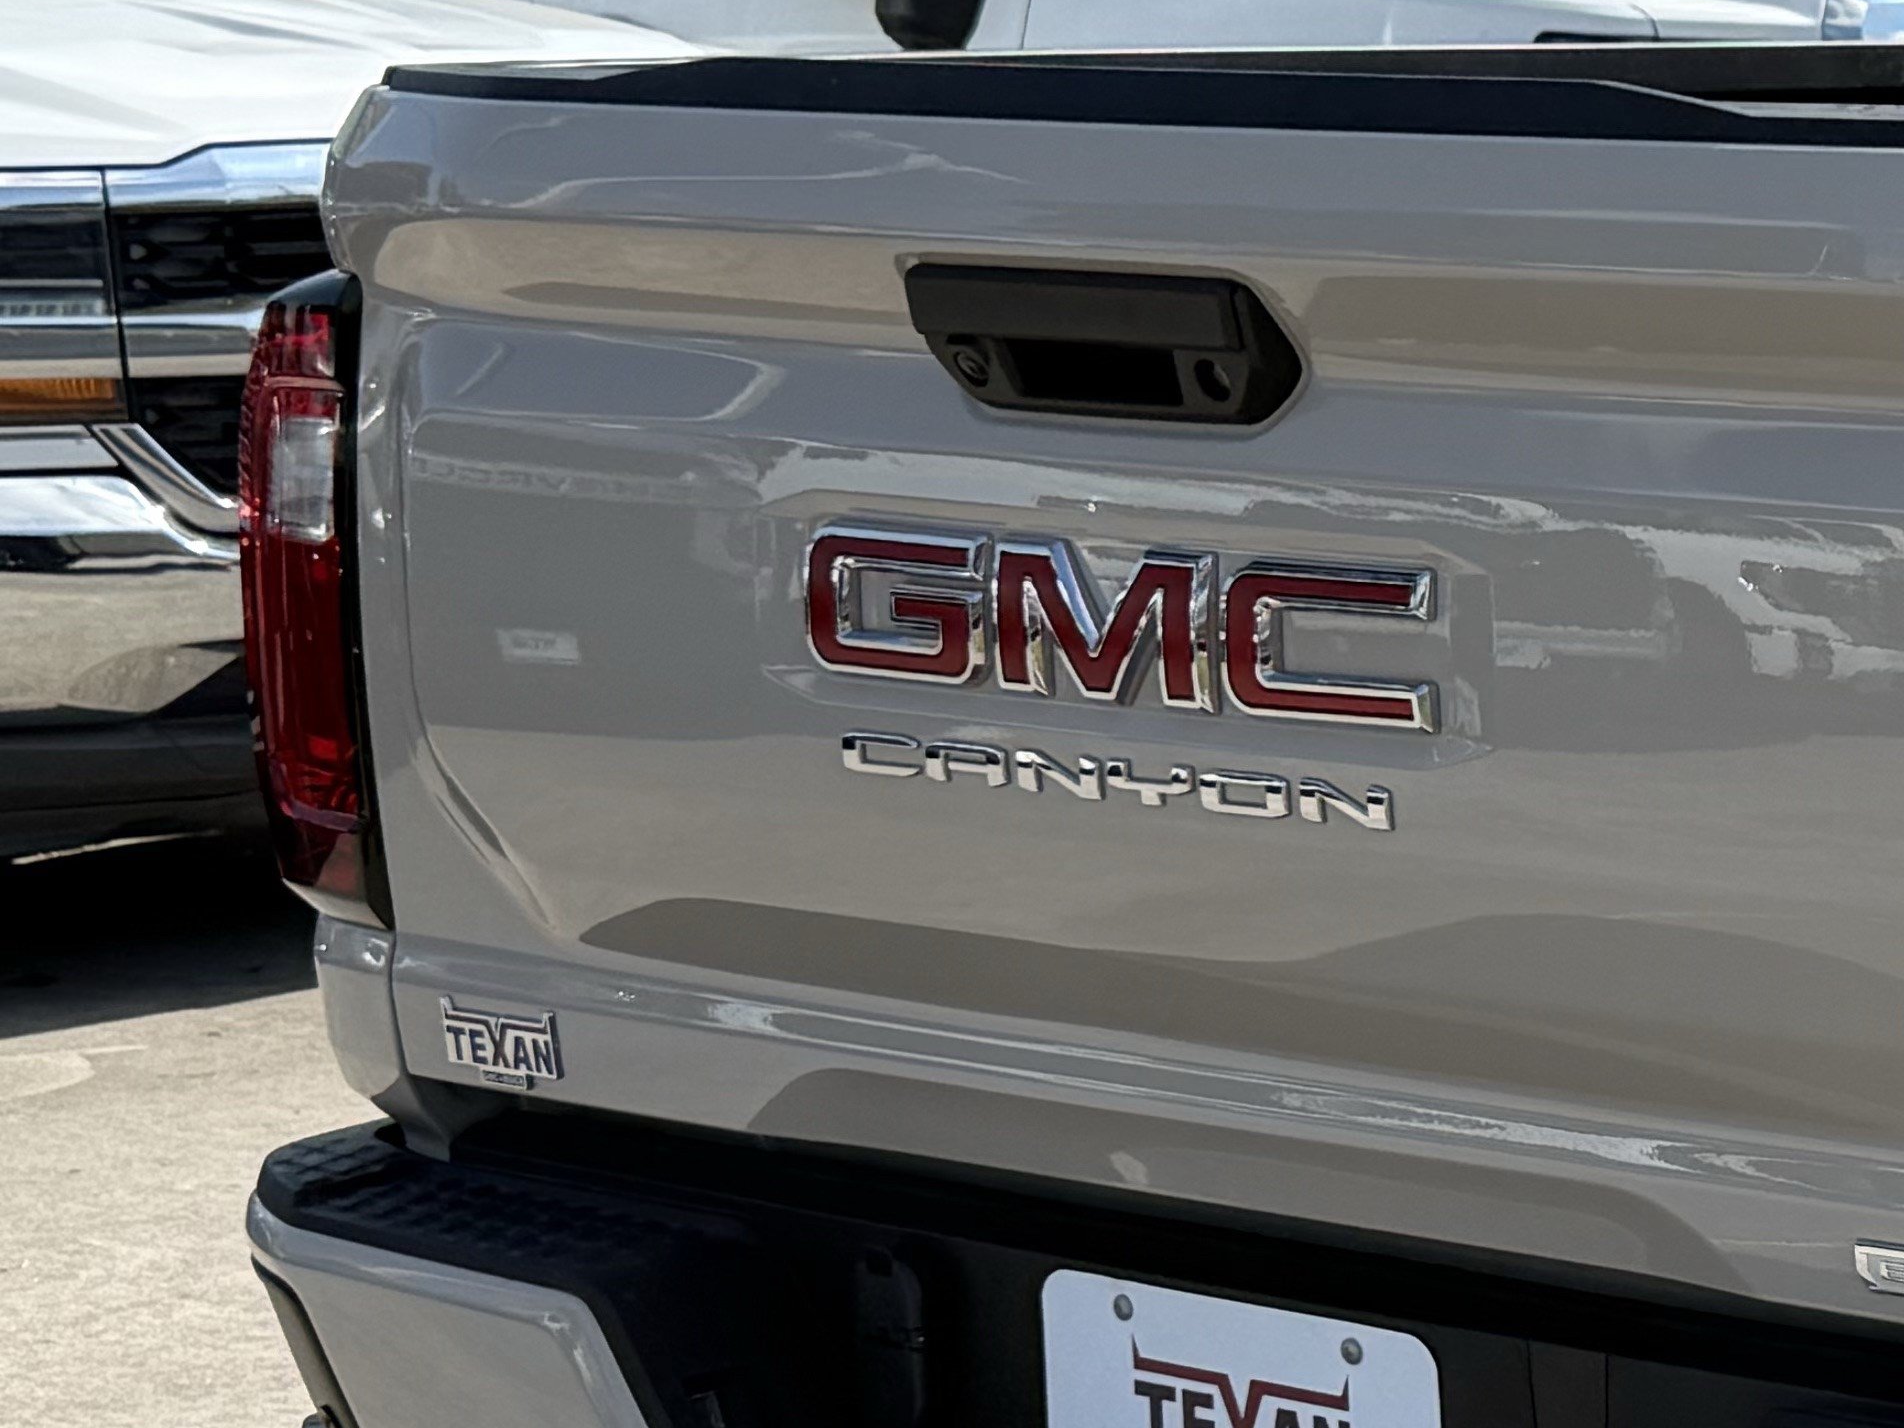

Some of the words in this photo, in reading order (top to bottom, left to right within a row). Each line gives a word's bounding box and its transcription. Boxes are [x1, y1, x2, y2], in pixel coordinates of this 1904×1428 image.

[805, 525, 1440, 733] GMC
[841, 731, 1395, 832] CANYON
[443, 1010, 557, 1077] TEXAN
